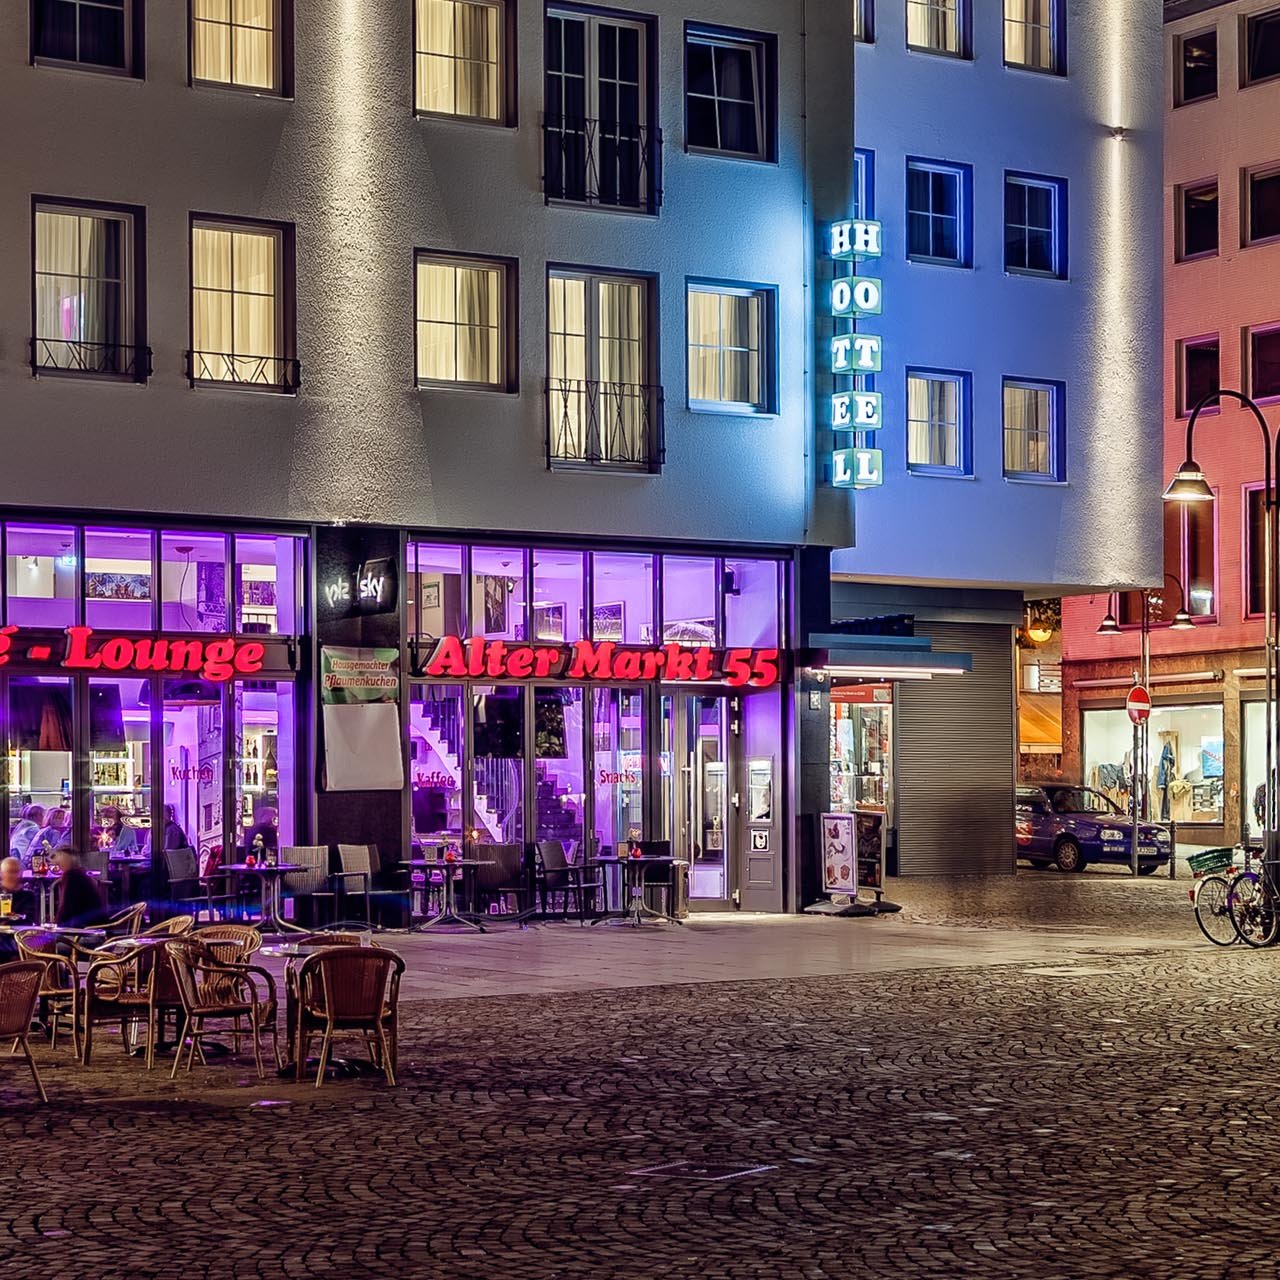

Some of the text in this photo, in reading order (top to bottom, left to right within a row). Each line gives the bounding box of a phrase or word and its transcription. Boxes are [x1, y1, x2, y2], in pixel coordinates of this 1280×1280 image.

[360, 572, 384, 602] sky
[60, 625, 265, 681] Lounge
[424, 635, 779, 687] Alter Markt 55
[332, 660, 390, 672] Hausgemachter
[324, 674, 397, 689] Pflaumenkuchen
[171, 766, 214, 781] Kuchen
[417, 771, 455, 788] Kaffee
[599, 769, 636, 785] Snacks
